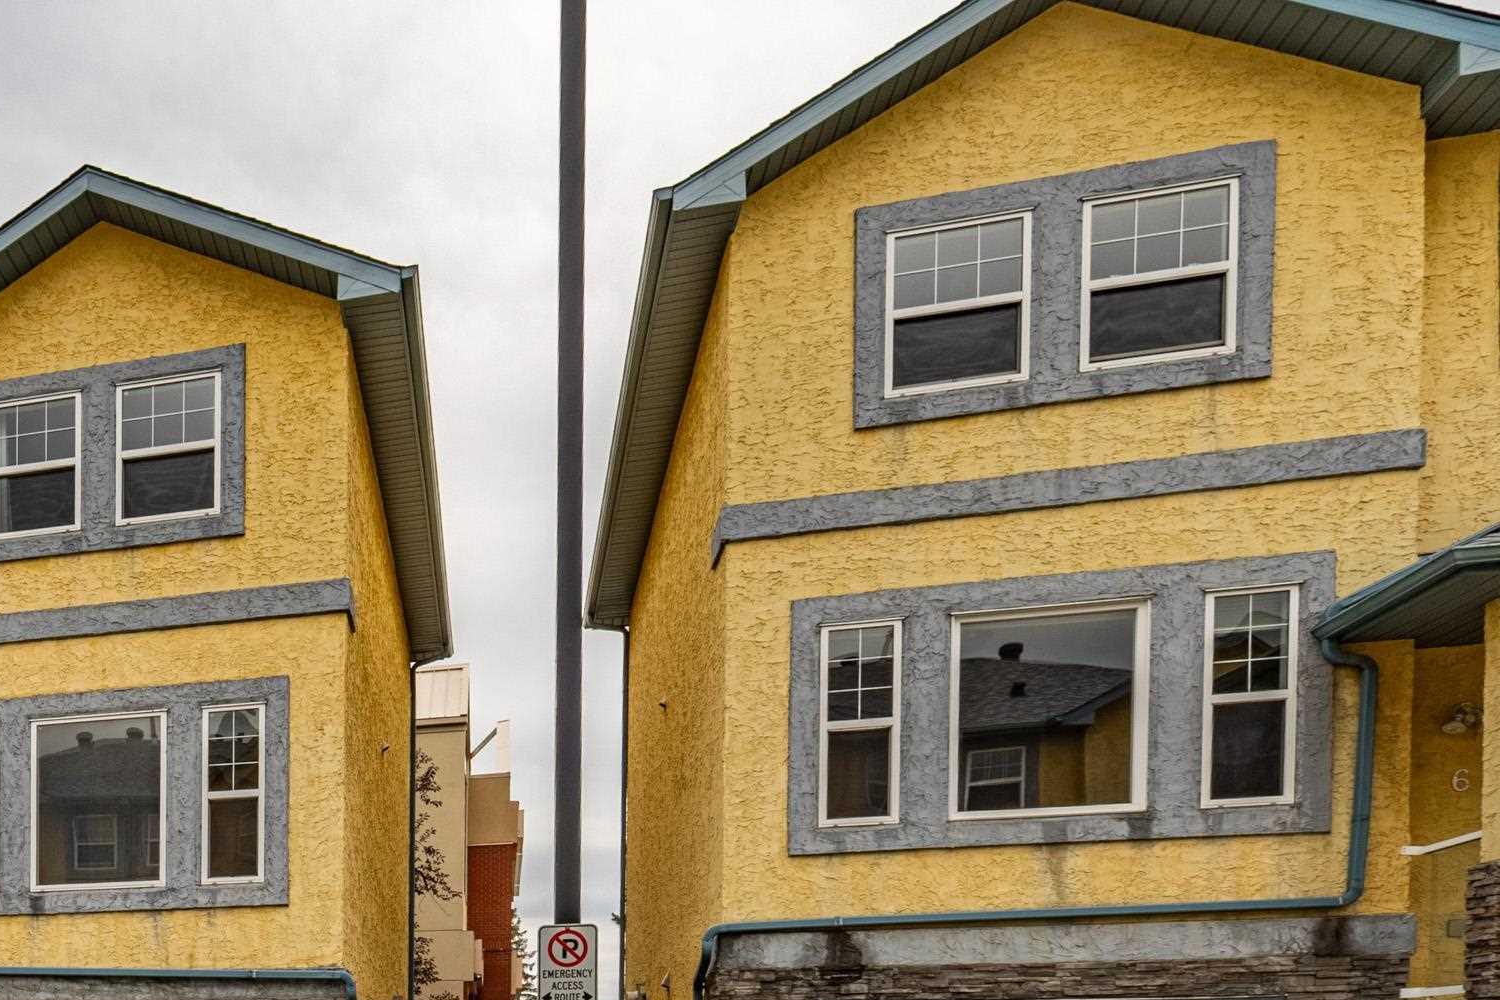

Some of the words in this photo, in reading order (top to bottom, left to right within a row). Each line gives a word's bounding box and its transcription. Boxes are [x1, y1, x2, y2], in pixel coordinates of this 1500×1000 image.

[1452, 768, 1469, 792] 6
[562, 938, 579, 959] P
[542, 969, 593, 979] EMERGENCY
[551, 981, 584, 991] ACCESS
